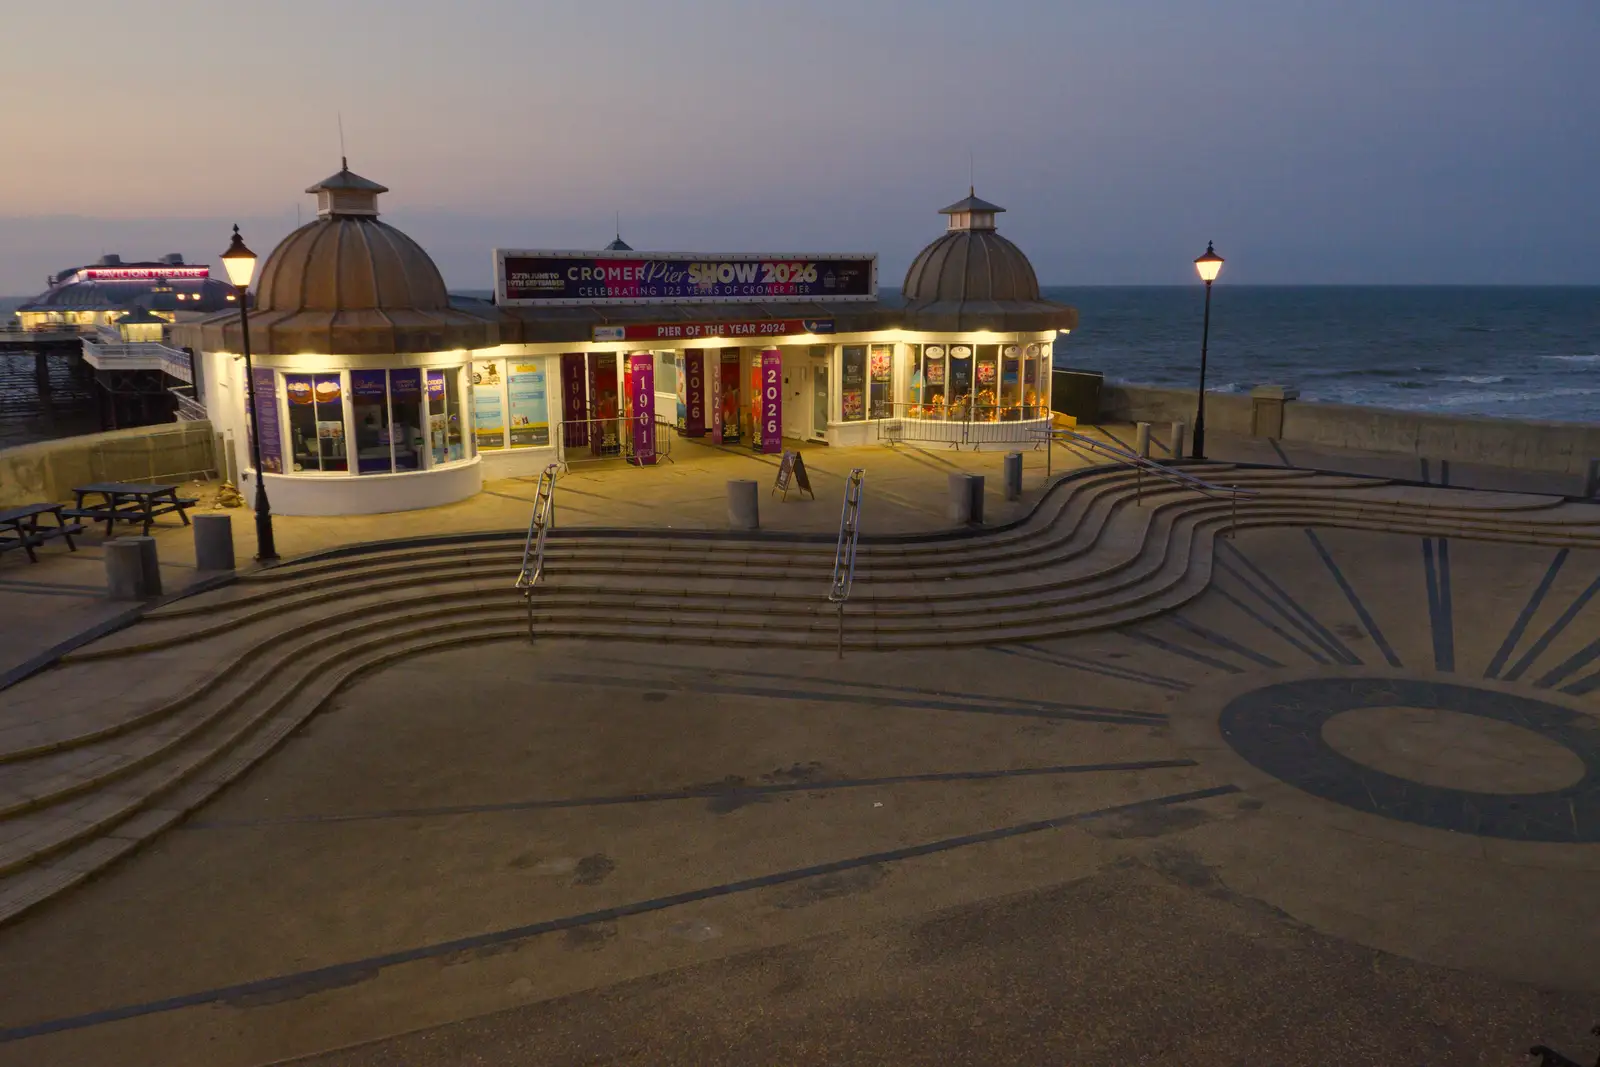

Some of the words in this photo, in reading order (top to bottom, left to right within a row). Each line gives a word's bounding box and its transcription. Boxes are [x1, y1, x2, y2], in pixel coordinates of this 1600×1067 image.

[95, 269, 149, 278] PAVILION
[151, 269, 200, 277] THEATRE
[567, 266, 645, 282] CROMER
[643, 261, 689, 284] Pier
[688, 262, 759, 284] SHOW
[760, 263, 818, 284] 2026
[579, 286, 657, 297] CELEBRATING
[663, 286, 681, 296] 125
[686, 285, 720, 296] YEARS
[725, 285, 738, 295] OF
[743, 285, 784, 295] CROMER
[789, 284, 810, 294] PIER
[657, 325, 681, 337] PIER
[686, 325, 700, 336] OF
[704, 324, 725, 335] THE
[728, 323, 756, 334] YEAR
[760, 323, 786, 333] 2024
[690, 361, 700, 419] 2026
[767, 369, 778, 434] 2026
[639, 375, 649, 444] 1901
